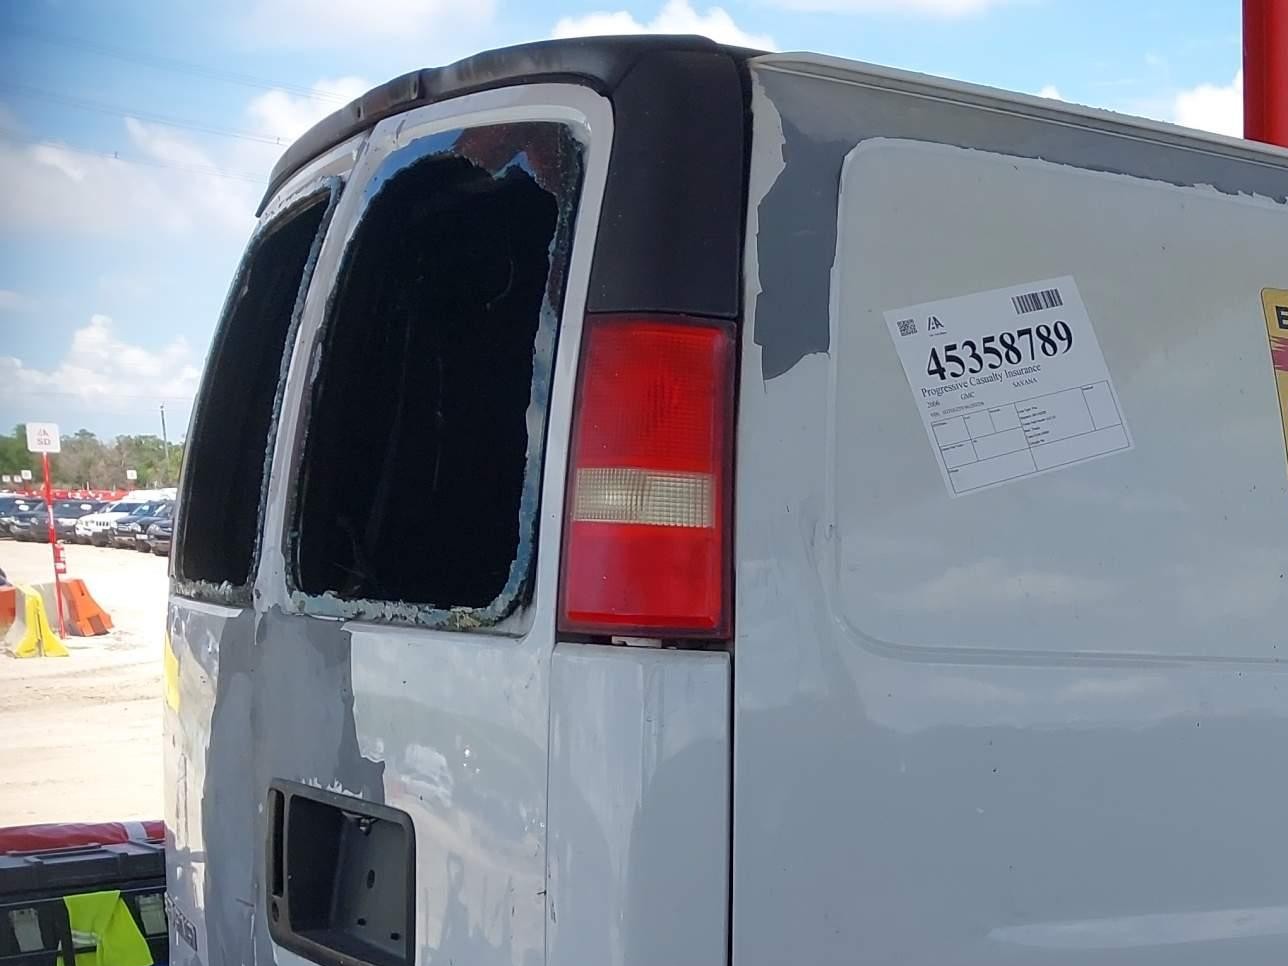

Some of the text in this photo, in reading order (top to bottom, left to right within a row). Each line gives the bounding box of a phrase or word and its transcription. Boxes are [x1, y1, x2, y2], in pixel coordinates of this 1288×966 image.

[927, 320, 1073, 381] 45358789
[921, 364, 1041, 398] Progressive Casualty Insurance
